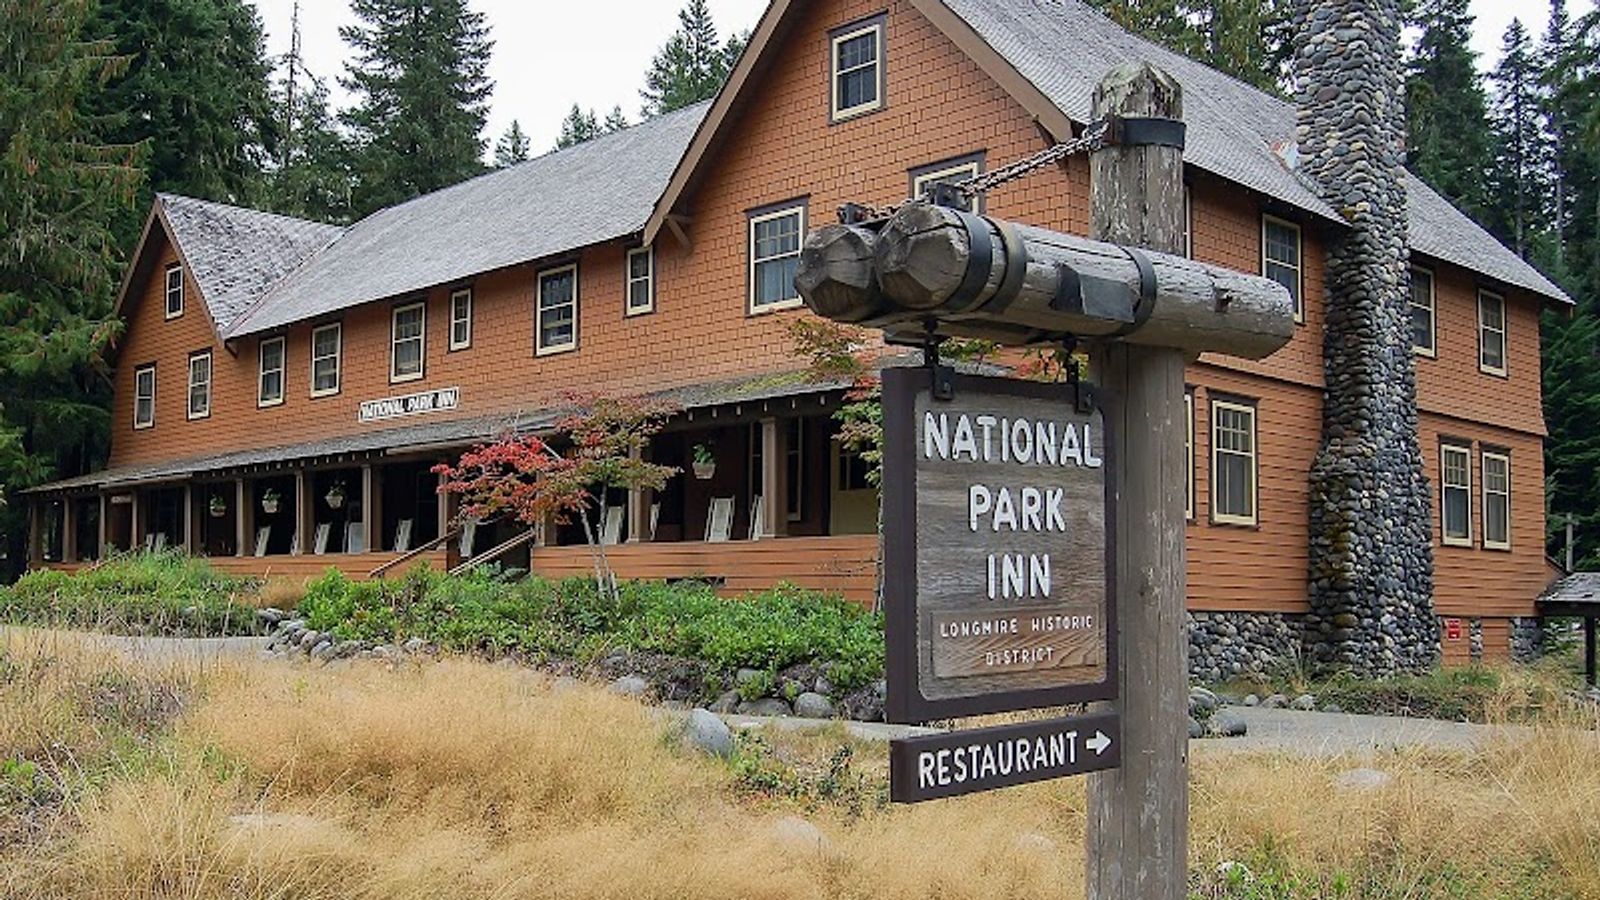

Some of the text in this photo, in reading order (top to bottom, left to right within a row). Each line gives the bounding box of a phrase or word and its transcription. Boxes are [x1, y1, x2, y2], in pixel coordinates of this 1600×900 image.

[362, 390, 455, 419] NATIONAL PARK INN
[923, 411, 1103, 468] NATIONAL
[969, 484, 1066, 532] PARK
[987, 553, 1050, 600] INN
[939, 614, 1093, 638] LONGMIRE HISTORIC
[984, 647, 1054, 666] DISTRICT
[918, 730, 1078, 789] RESTAURANT
